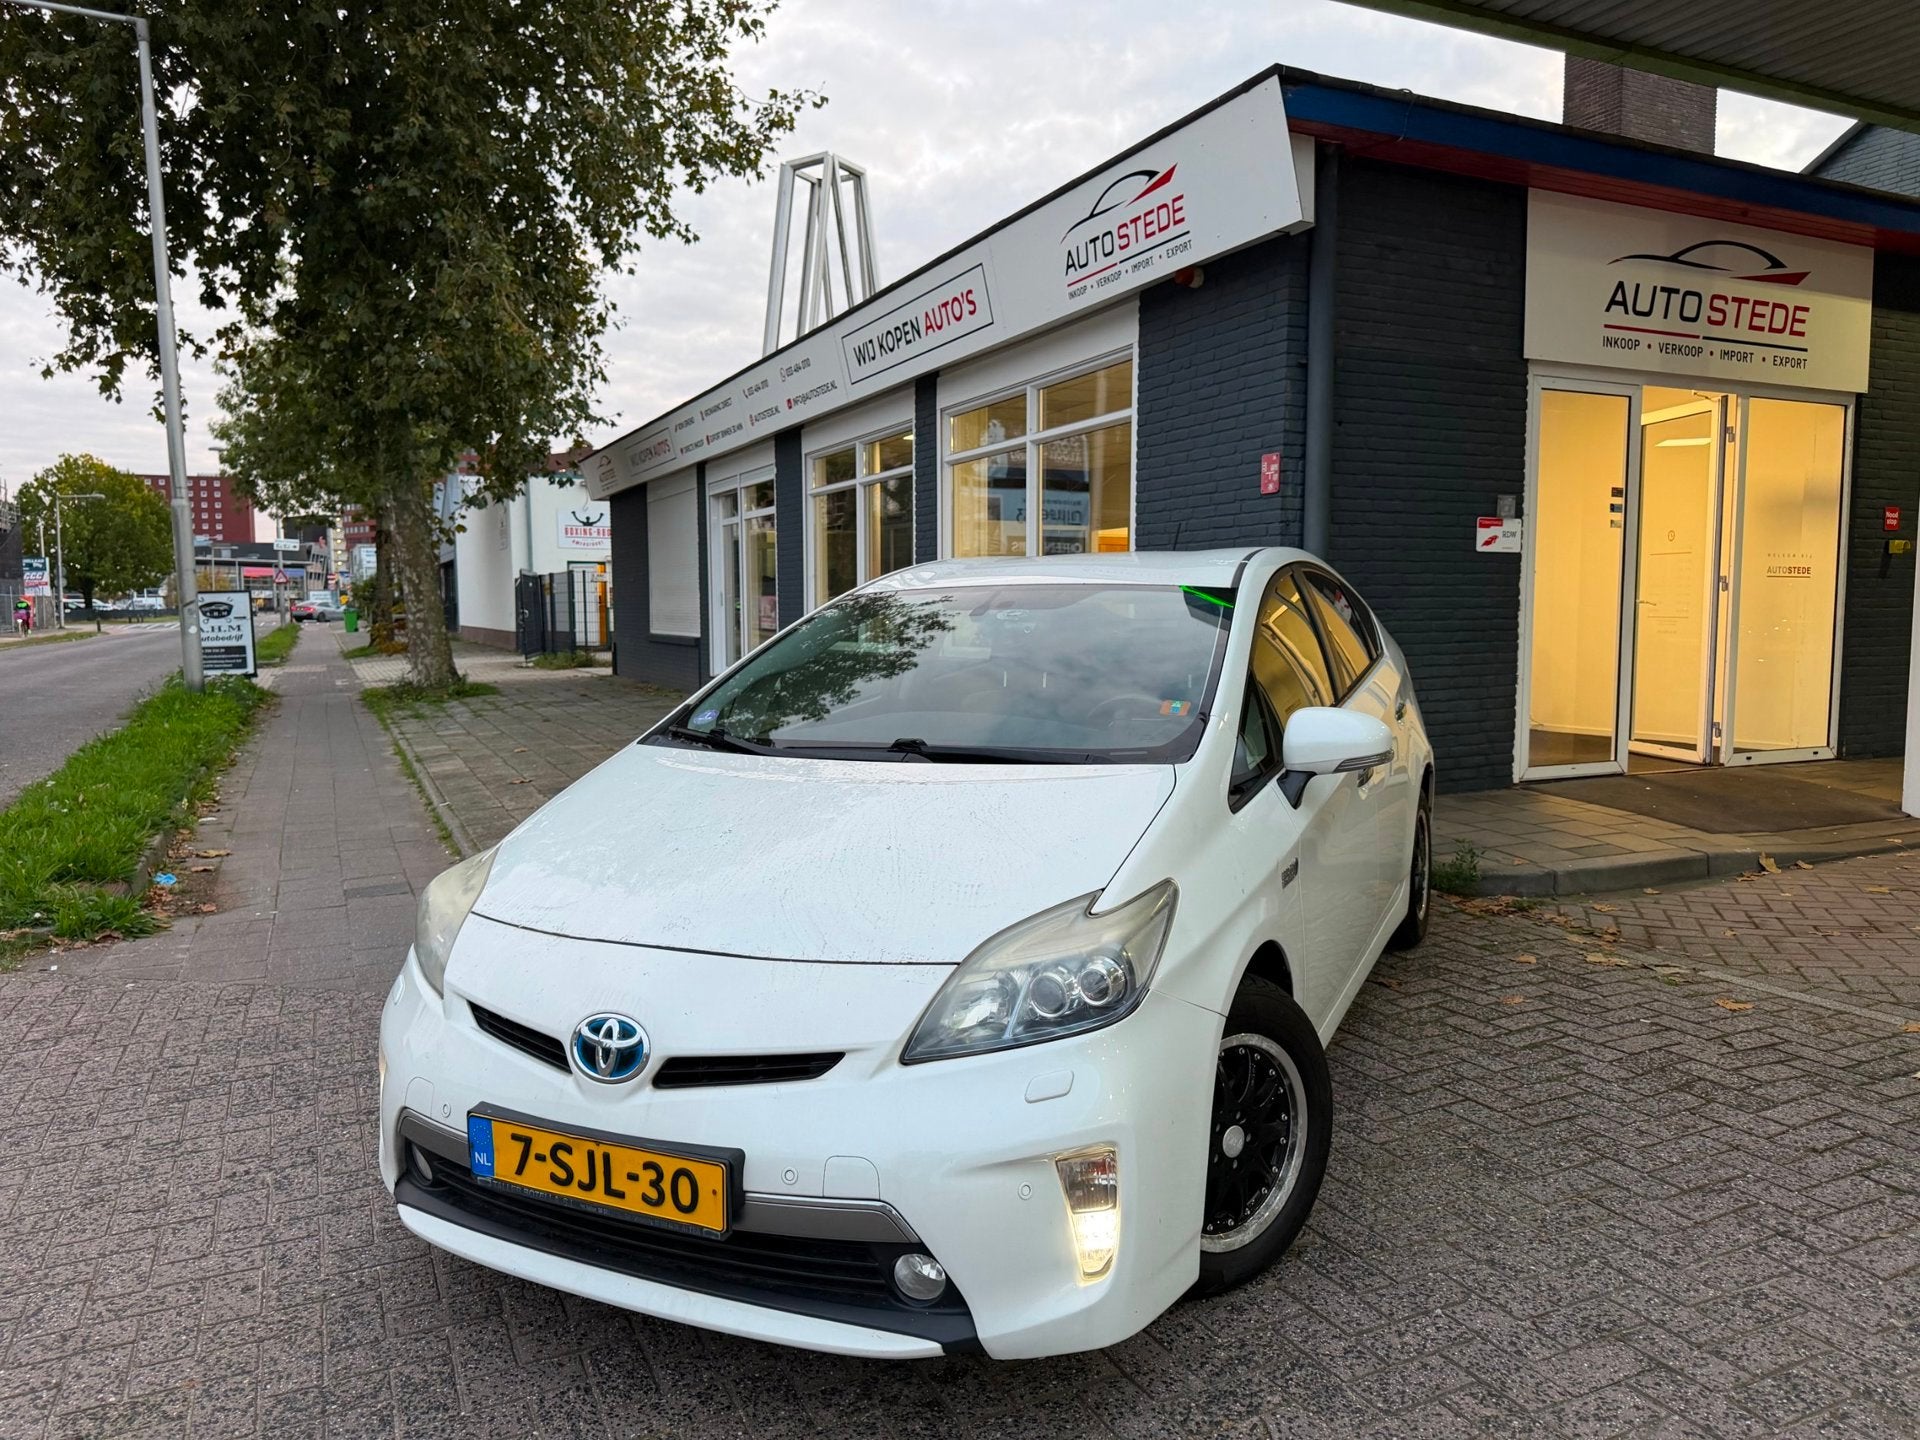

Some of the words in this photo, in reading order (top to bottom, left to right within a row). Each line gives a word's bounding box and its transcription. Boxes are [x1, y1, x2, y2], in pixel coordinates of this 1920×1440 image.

[1068, 285, 1088, 300] INKOOP
[1096, 269, 1122, 288] VERKOOP
[1131, 256, 1154, 273] IMPORT
[1166, 240, 1192, 258] EXPORT
[853, 337, 876, 367] WIJ
[877, 316, 922, 357] KOPEN
[924, 289, 977, 336] AUTO'S
[1602, 335, 1641, 352] INKOOP
[1658, 342, 1704, 358] VERKOOP
[1719, 348, 1755, 364] IMPORT
[1772, 355, 1808, 370] EXPORT
[565, 527, 612, 537] BOXING-ROO
[1502, 530, 1518, 538] RDW
[1766, 565, 1812, 575] AUTOSTEDE
[201, 634, 244, 642] utobedrijf
[475, 1151, 492, 1167] NL
[509, 1132, 700, 1214] 7-SJL-30
